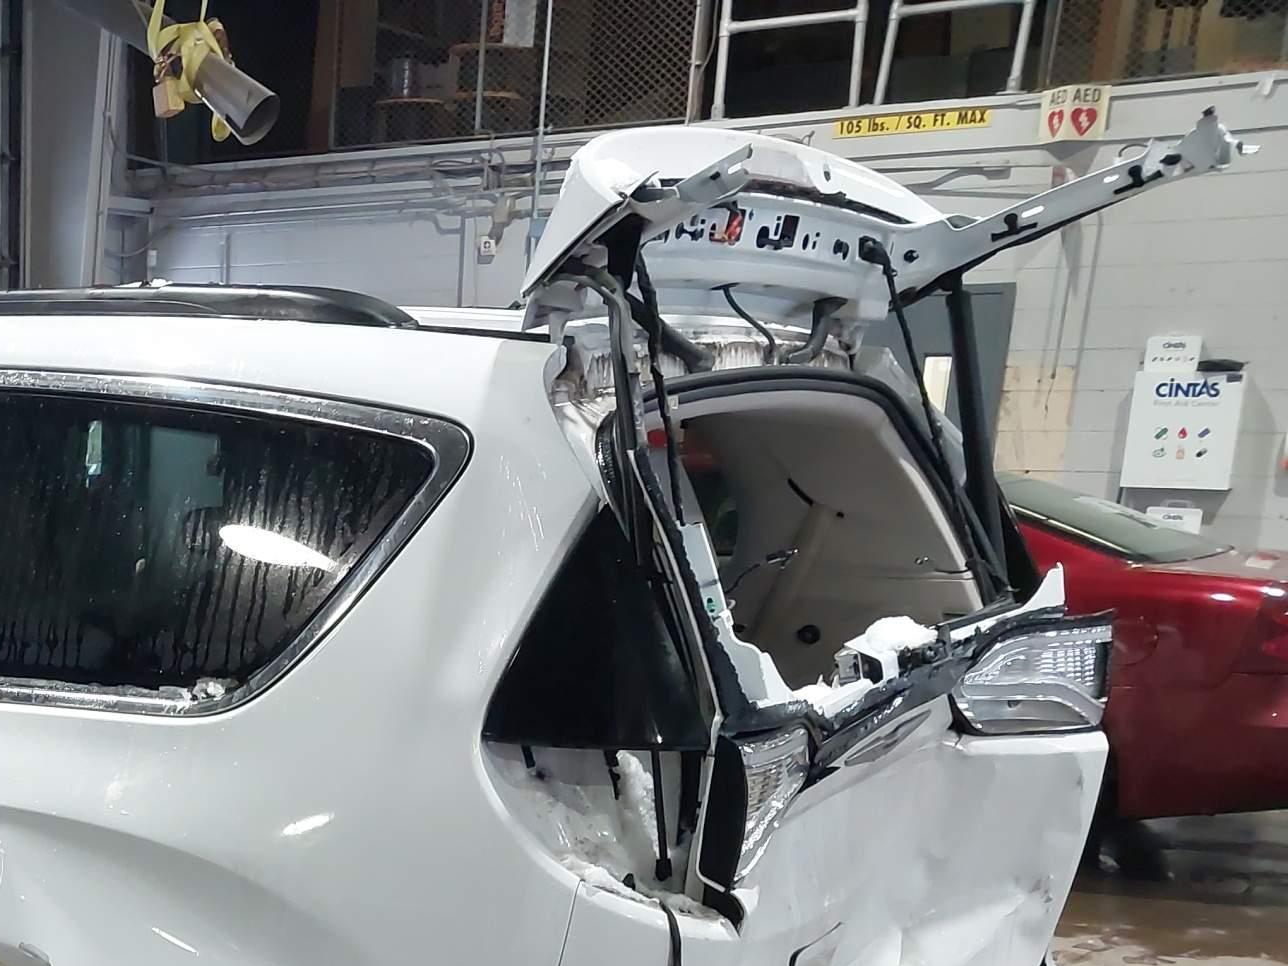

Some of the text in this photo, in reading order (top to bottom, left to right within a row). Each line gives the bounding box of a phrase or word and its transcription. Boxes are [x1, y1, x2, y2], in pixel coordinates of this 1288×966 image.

[1049, 91, 1068, 106] AED
[1073, 88, 1102, 103] AED
[840, 121, 862, 135] 105
[867, 118, 890, 132] lbs.
[906, 115, 927, 130] SQ.
[933, 113, 951, 127] FT.
[957, 110, 987, 125] MAX
